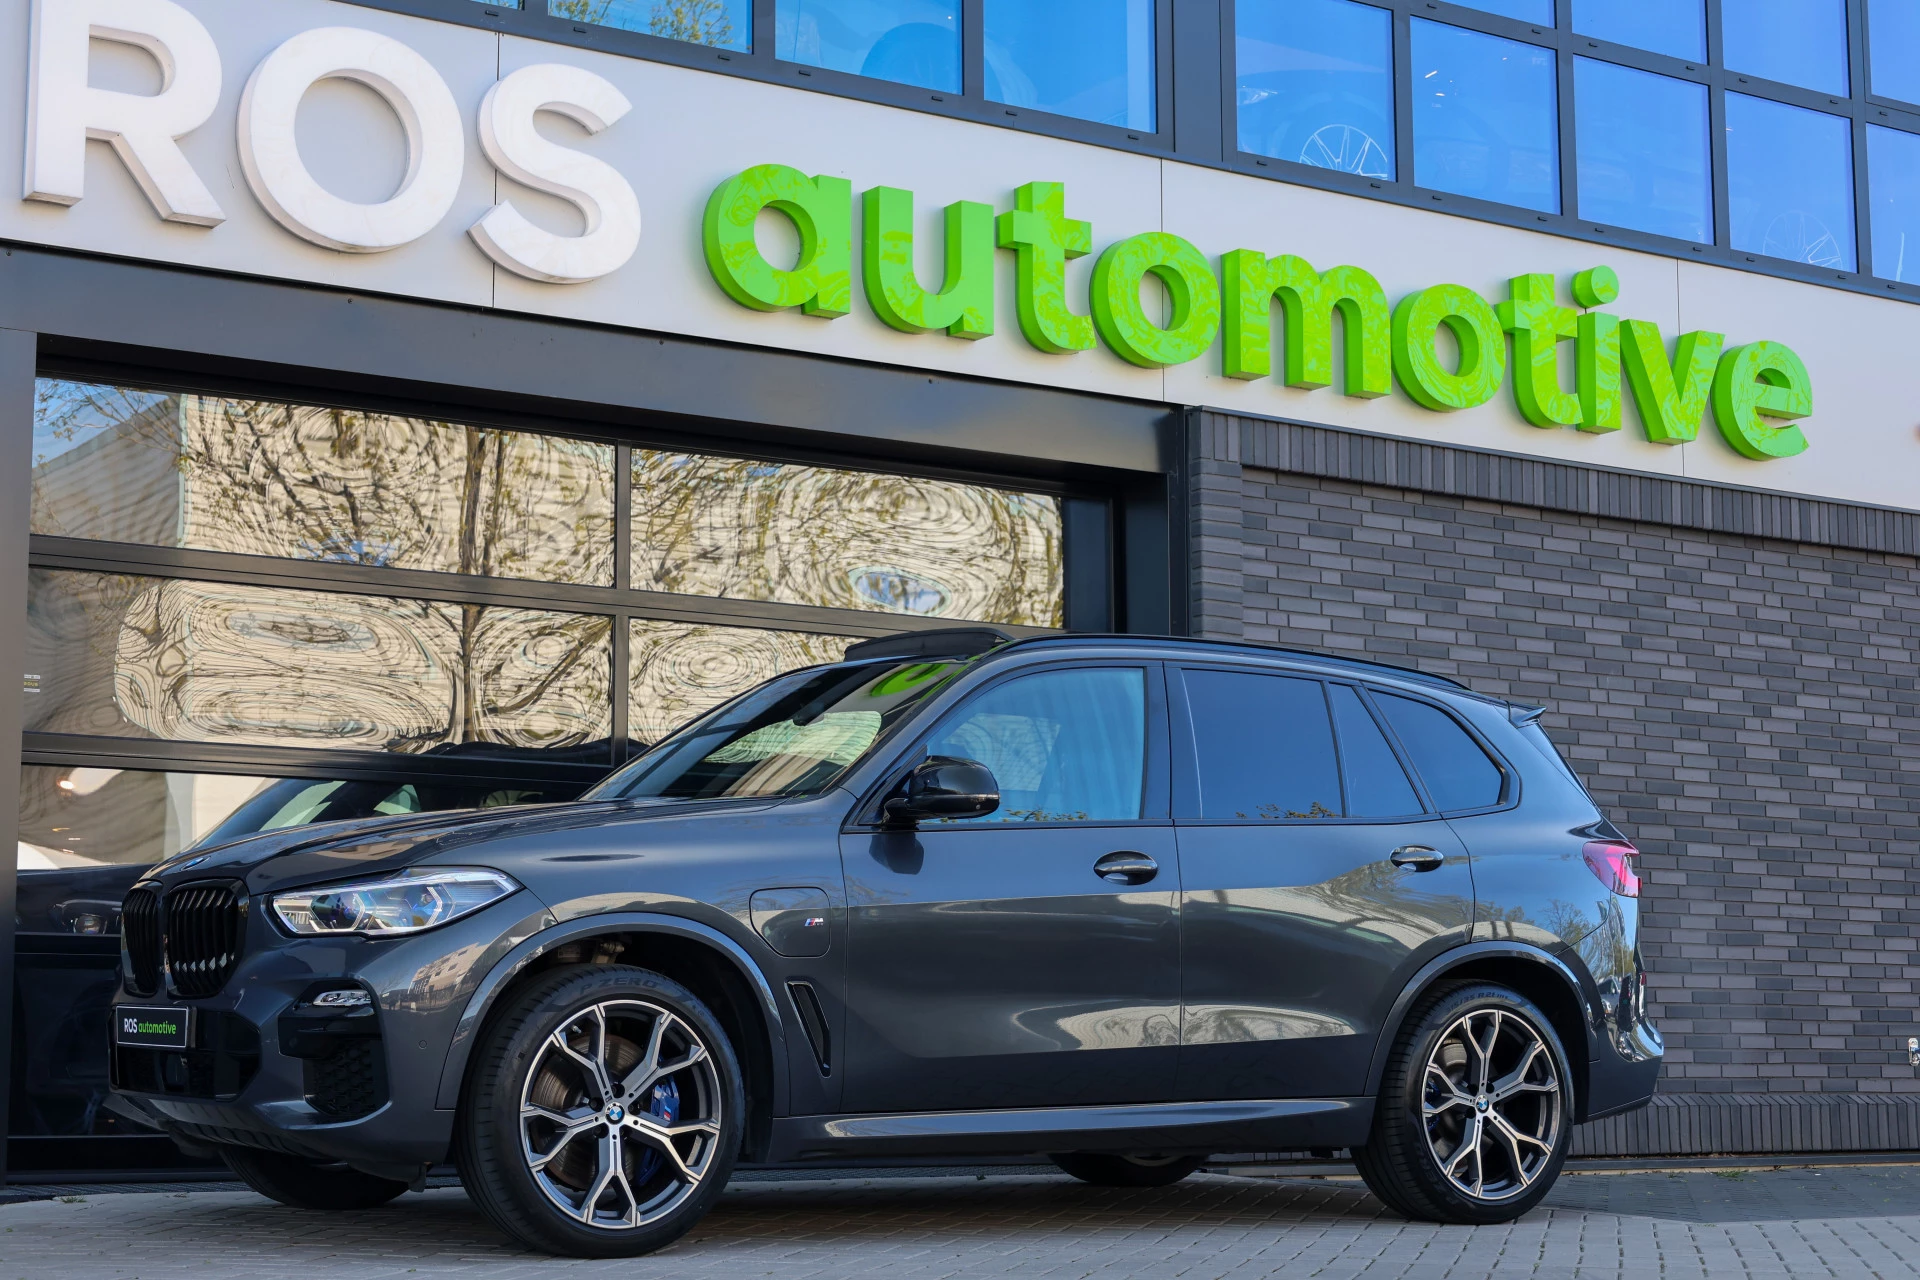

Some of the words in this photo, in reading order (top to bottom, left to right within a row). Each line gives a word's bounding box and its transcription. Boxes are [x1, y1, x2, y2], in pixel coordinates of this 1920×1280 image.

[22, 0, 641, 284] ROS
[702, 163, 1813, 461] automotive
[580, 983, 593, 995] P
[598, 976, 659, 988] ZERO
[124, 1018, 138, 1033] ROS
[138, 1021, 177, 1034] automotive
